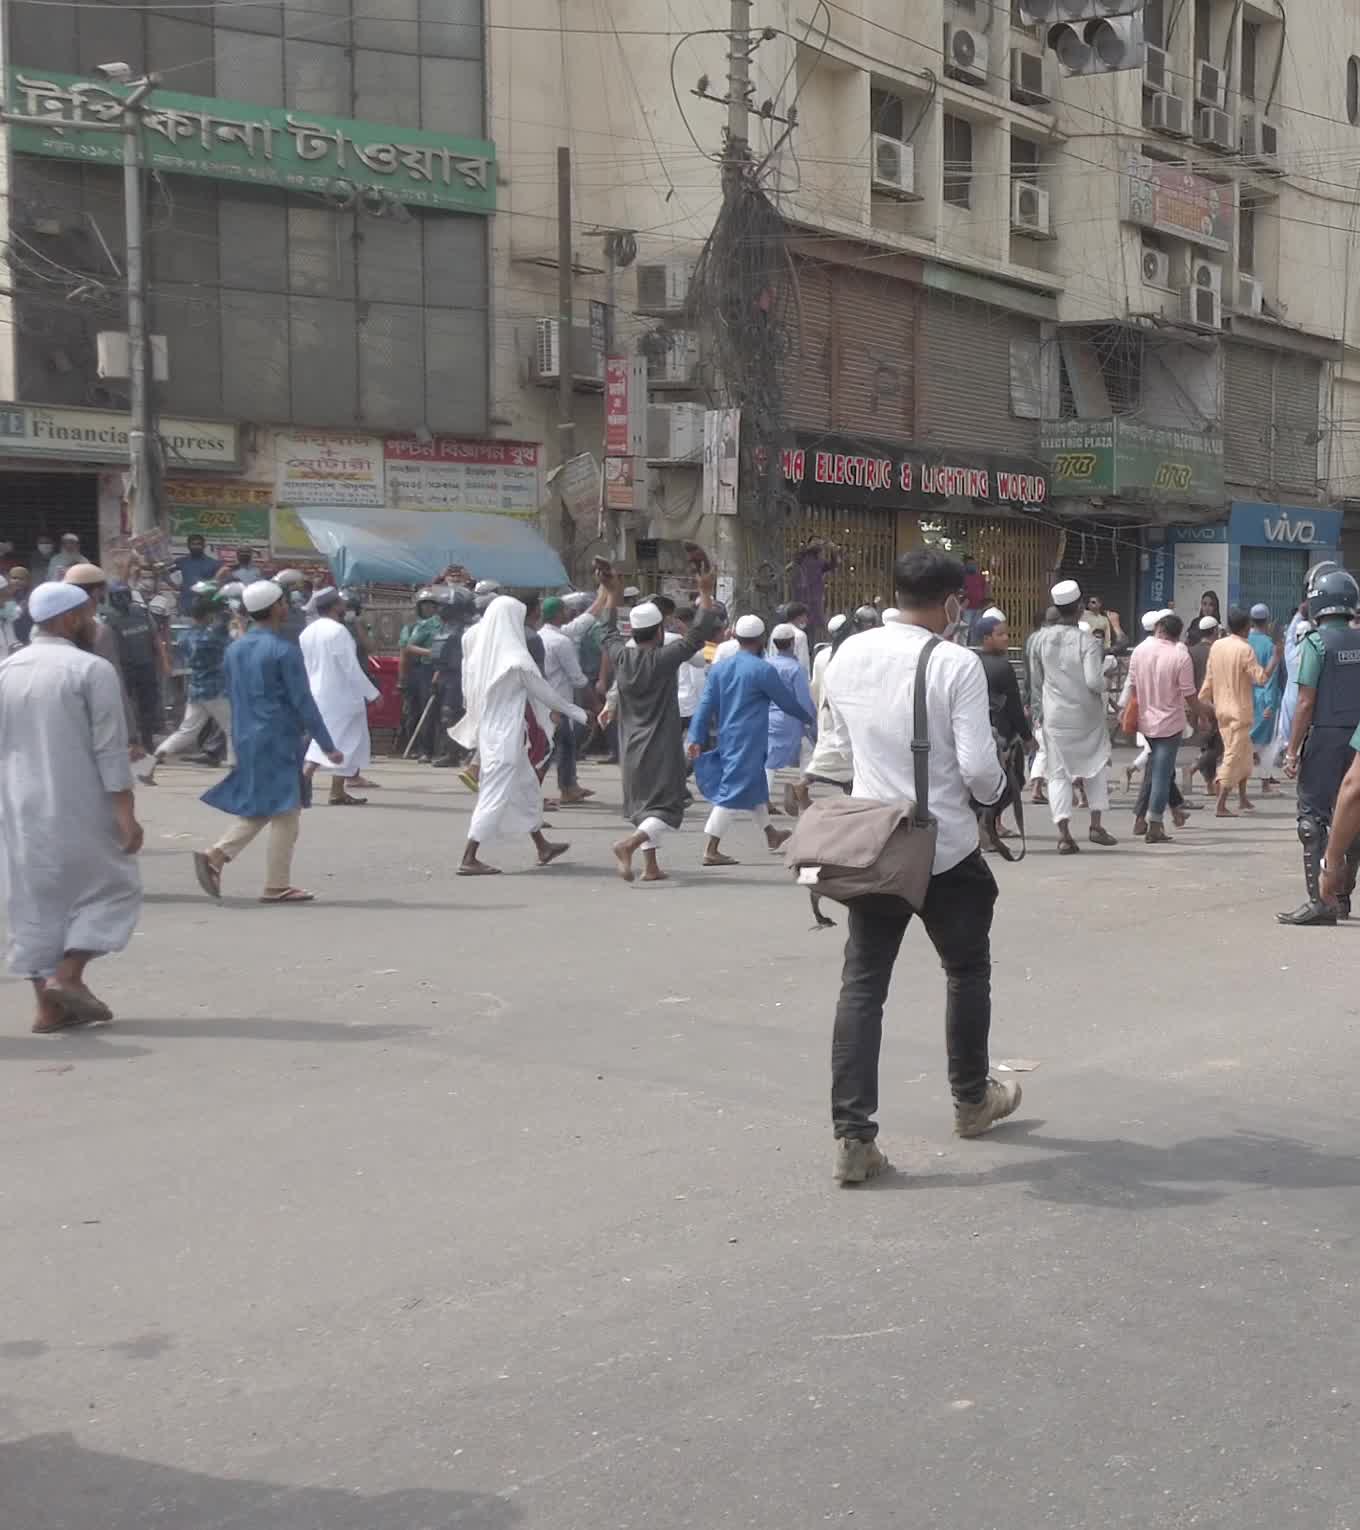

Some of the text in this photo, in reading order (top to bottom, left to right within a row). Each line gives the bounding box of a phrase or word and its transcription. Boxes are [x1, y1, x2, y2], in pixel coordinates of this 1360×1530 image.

[285, 113, 493, 192] টাওয়ার
[32, 420, 226, 452] Financia xpress
[815, 451, 892, 491] ELECTRIC
[900, 463, 913, 492] &
[921, 464, 989, 498] LIGHTING
[997, 471, 1046, 504] WORLD
[1264, 512, 1316, 544] vivo
